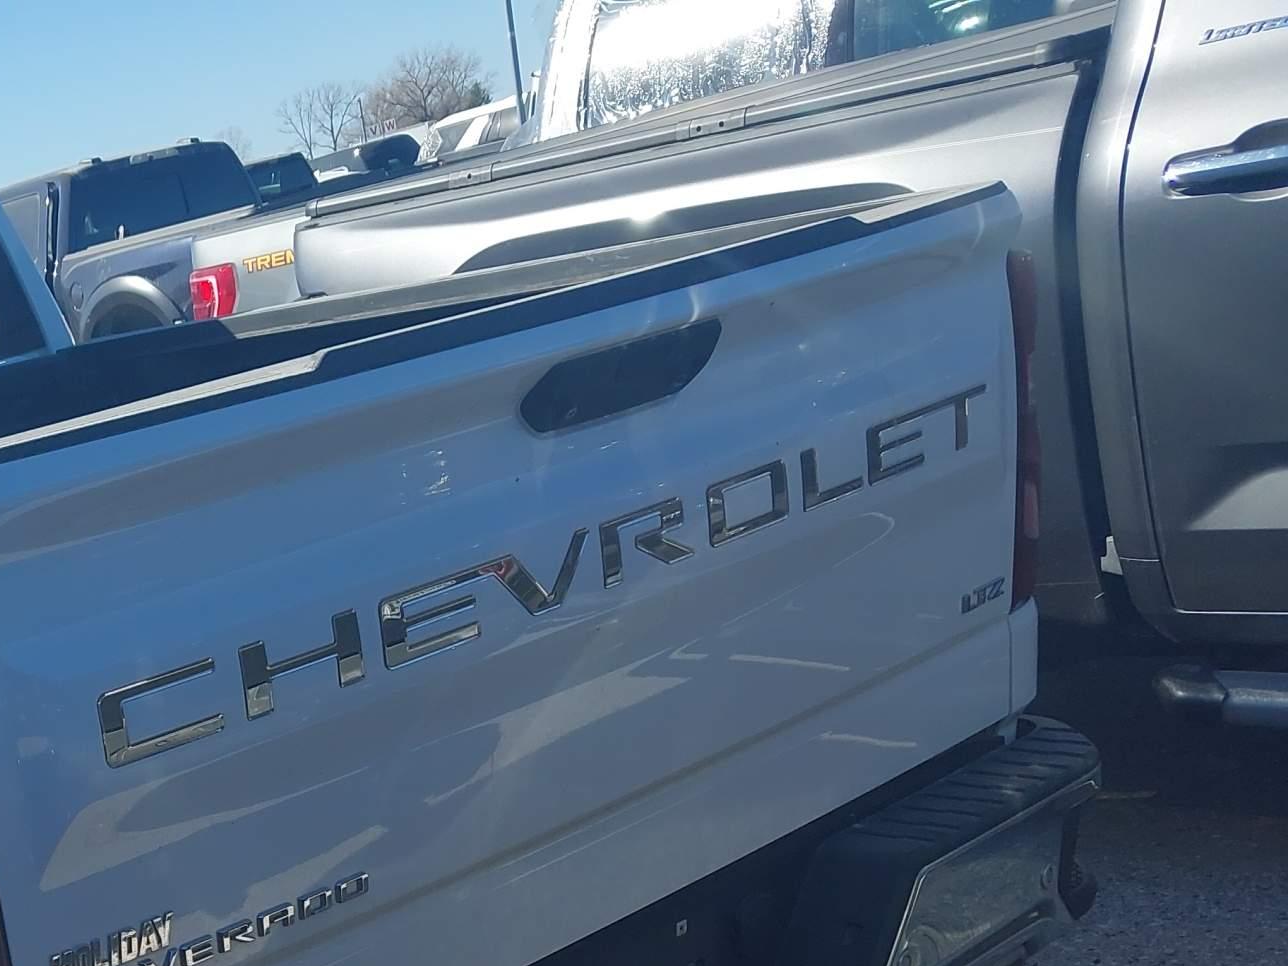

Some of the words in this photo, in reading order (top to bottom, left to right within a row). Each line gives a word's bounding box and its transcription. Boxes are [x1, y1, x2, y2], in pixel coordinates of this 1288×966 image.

[384, 119, 396, 131] W
[97, 383, 987, 769] CHEVROLET
[961, 576, 1006, 615] LTZ
